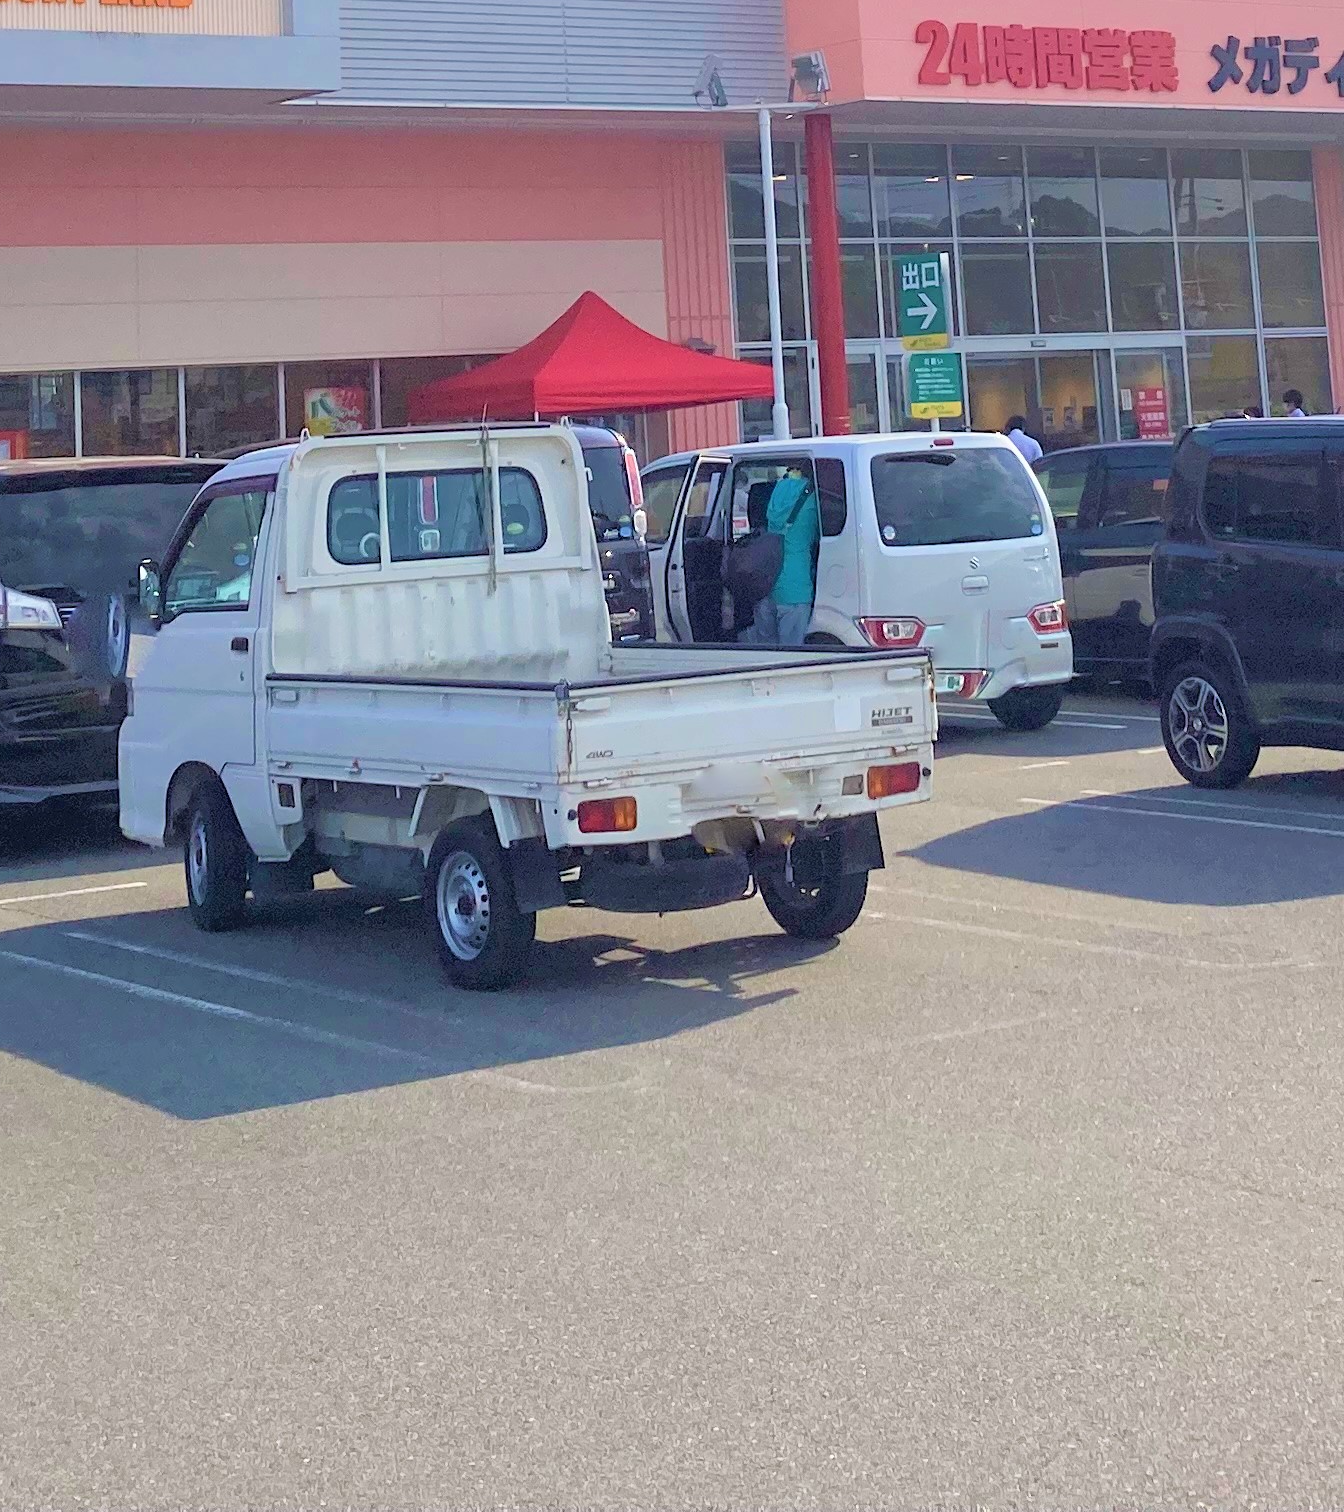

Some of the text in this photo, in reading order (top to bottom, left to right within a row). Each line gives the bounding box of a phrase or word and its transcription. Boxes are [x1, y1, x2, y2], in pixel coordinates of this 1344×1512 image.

[915, 19, 1180, 92] 24時間営業
[902, 261, 940, 291] 出口
[871, 706, 913, 718] HIJET
[585, 750, 614, 759] 4WD
